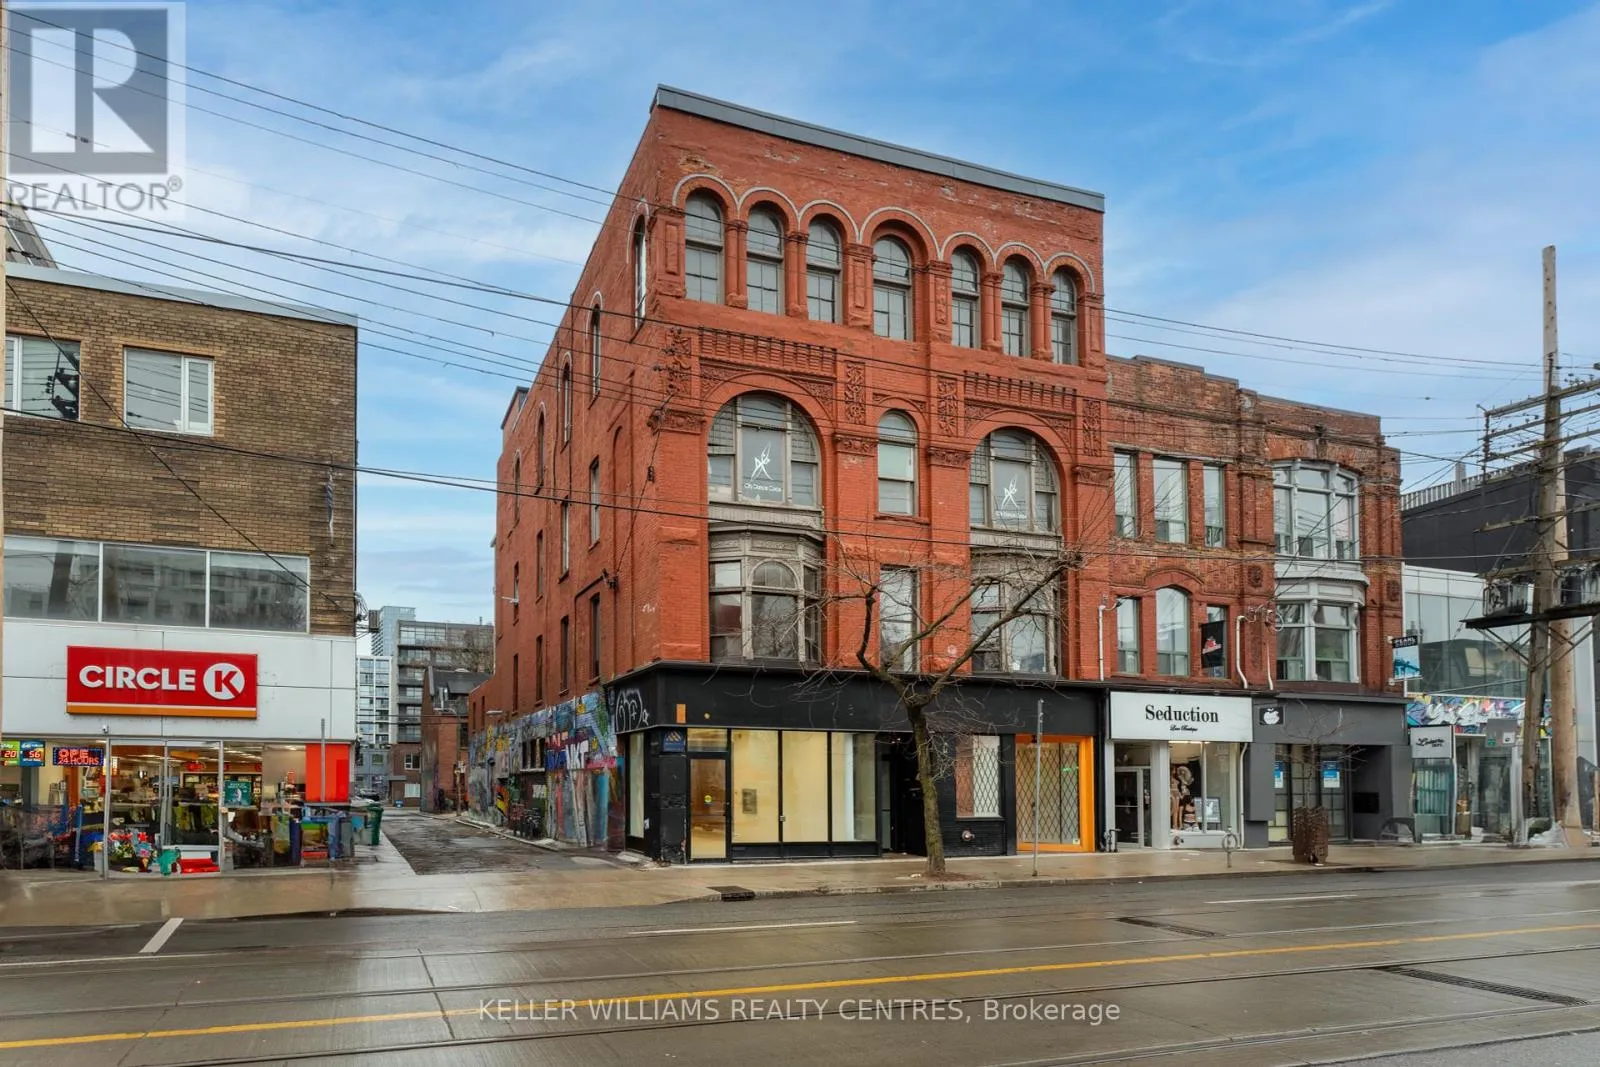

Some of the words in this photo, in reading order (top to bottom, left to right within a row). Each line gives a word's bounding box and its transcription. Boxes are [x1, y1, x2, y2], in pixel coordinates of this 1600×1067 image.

[78, 664, 196, 692] CIRCLE
[209, 667, 243, 699] K
[1145, 704, 1219, 723] Seduction
[70, 757, 99, 765] HOURS
